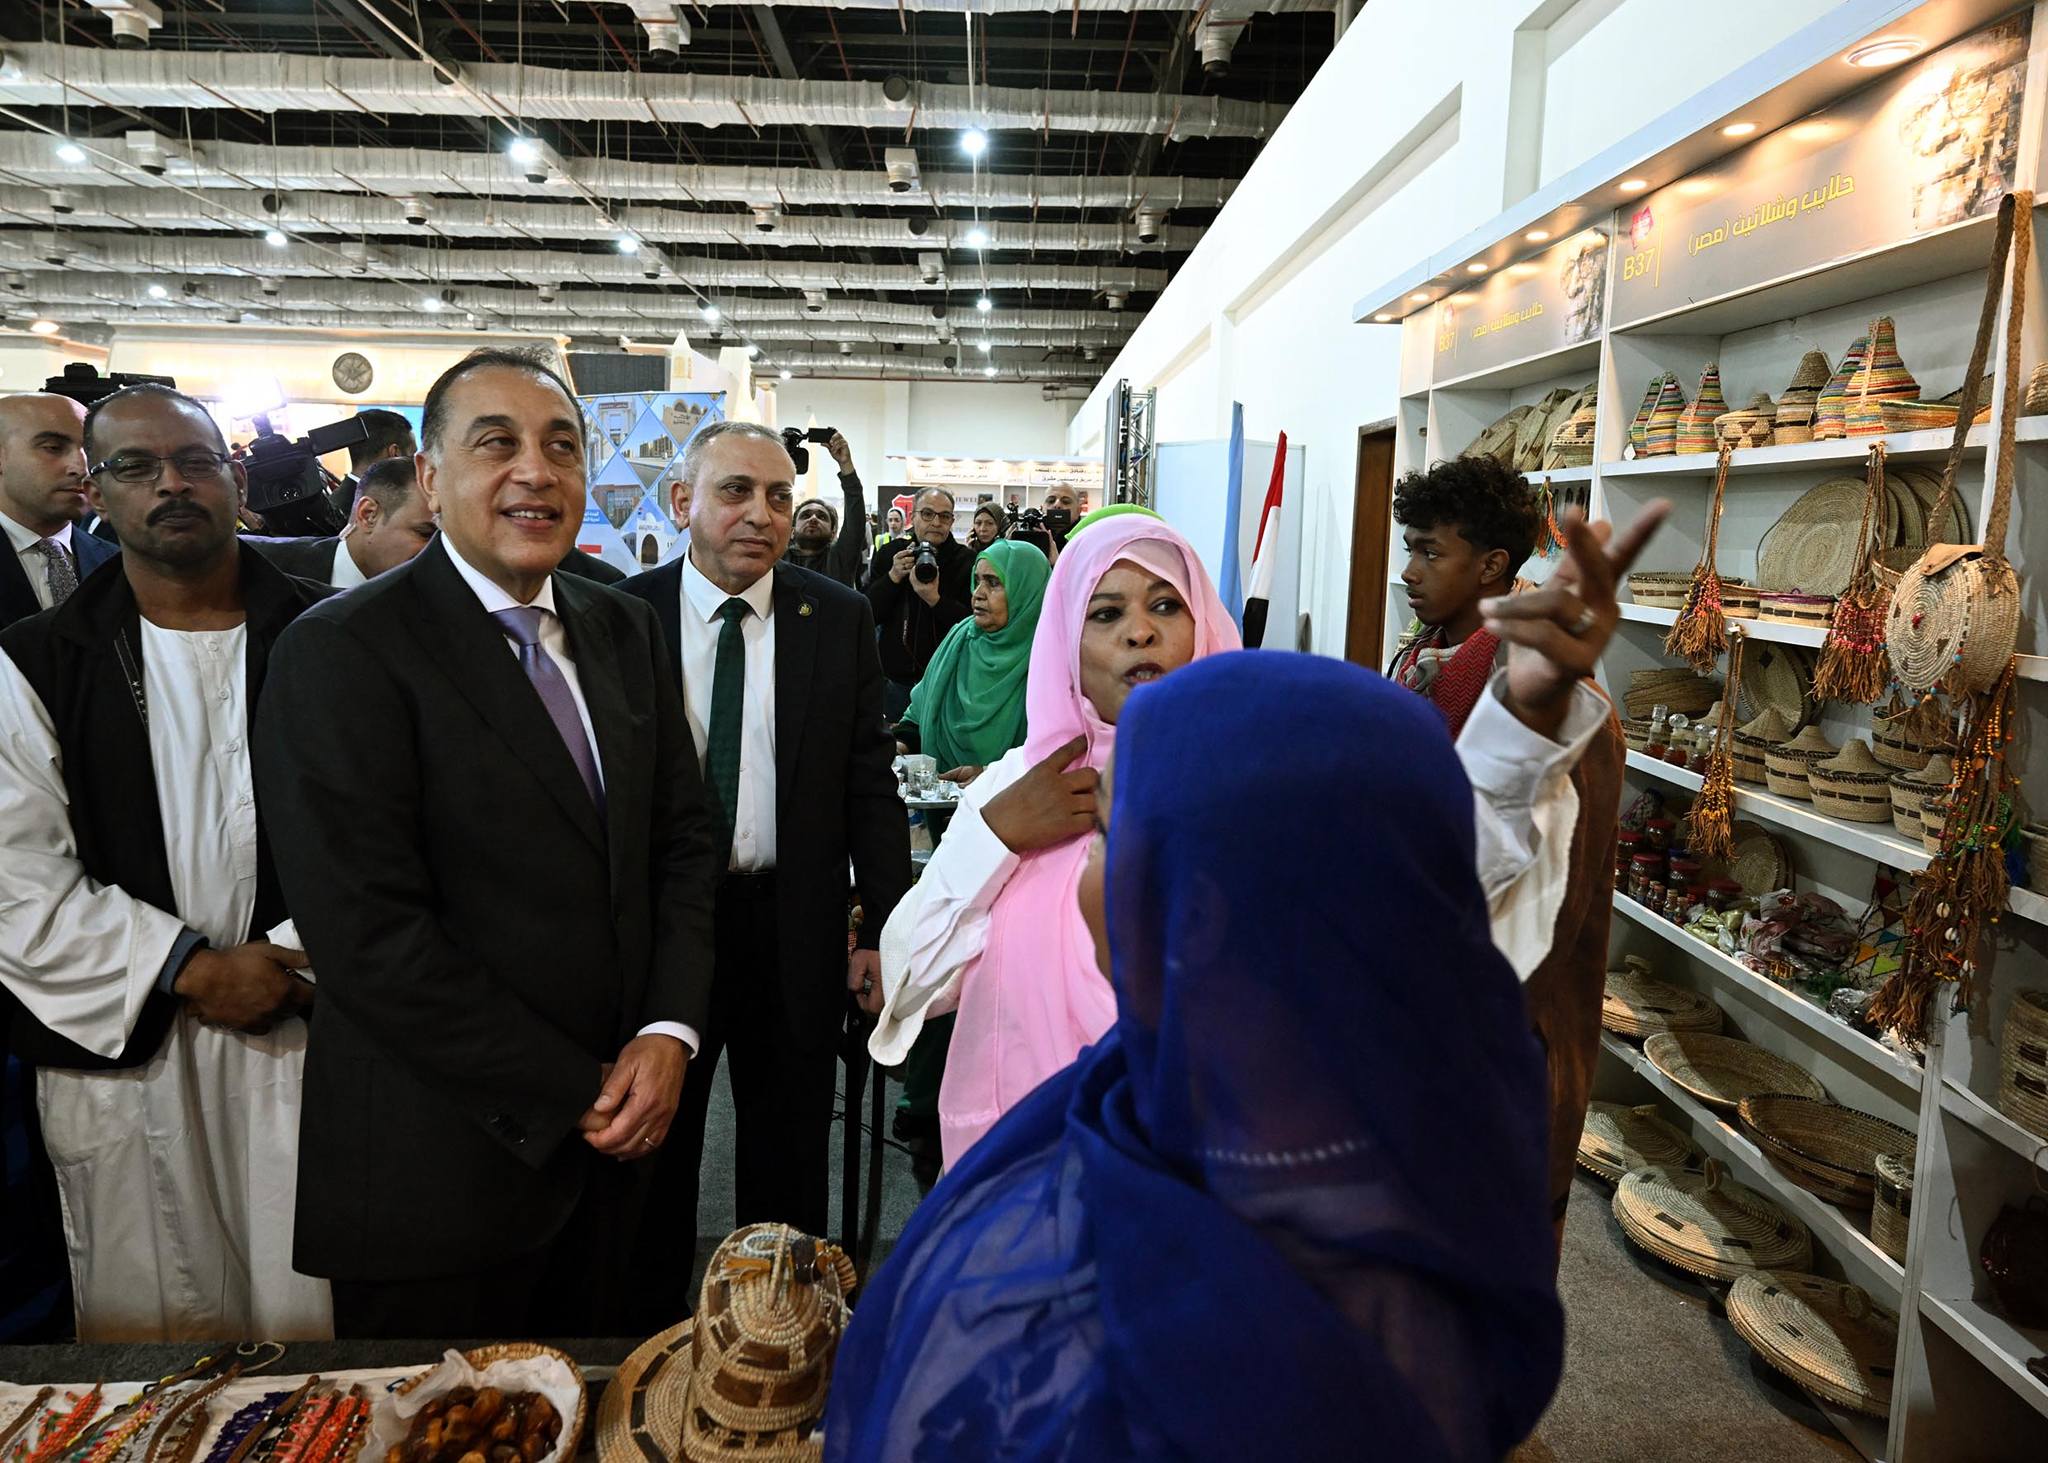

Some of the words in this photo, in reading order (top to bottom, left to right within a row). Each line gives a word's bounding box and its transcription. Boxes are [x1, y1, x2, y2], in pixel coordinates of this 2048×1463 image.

[1800, 173, 1856, 215] حلايب
[1732, 194, 1798, 238] وشلاتين
[1688, 220, 1730, 256] (مصر)
[1623, 247, 1656, 281] B37
